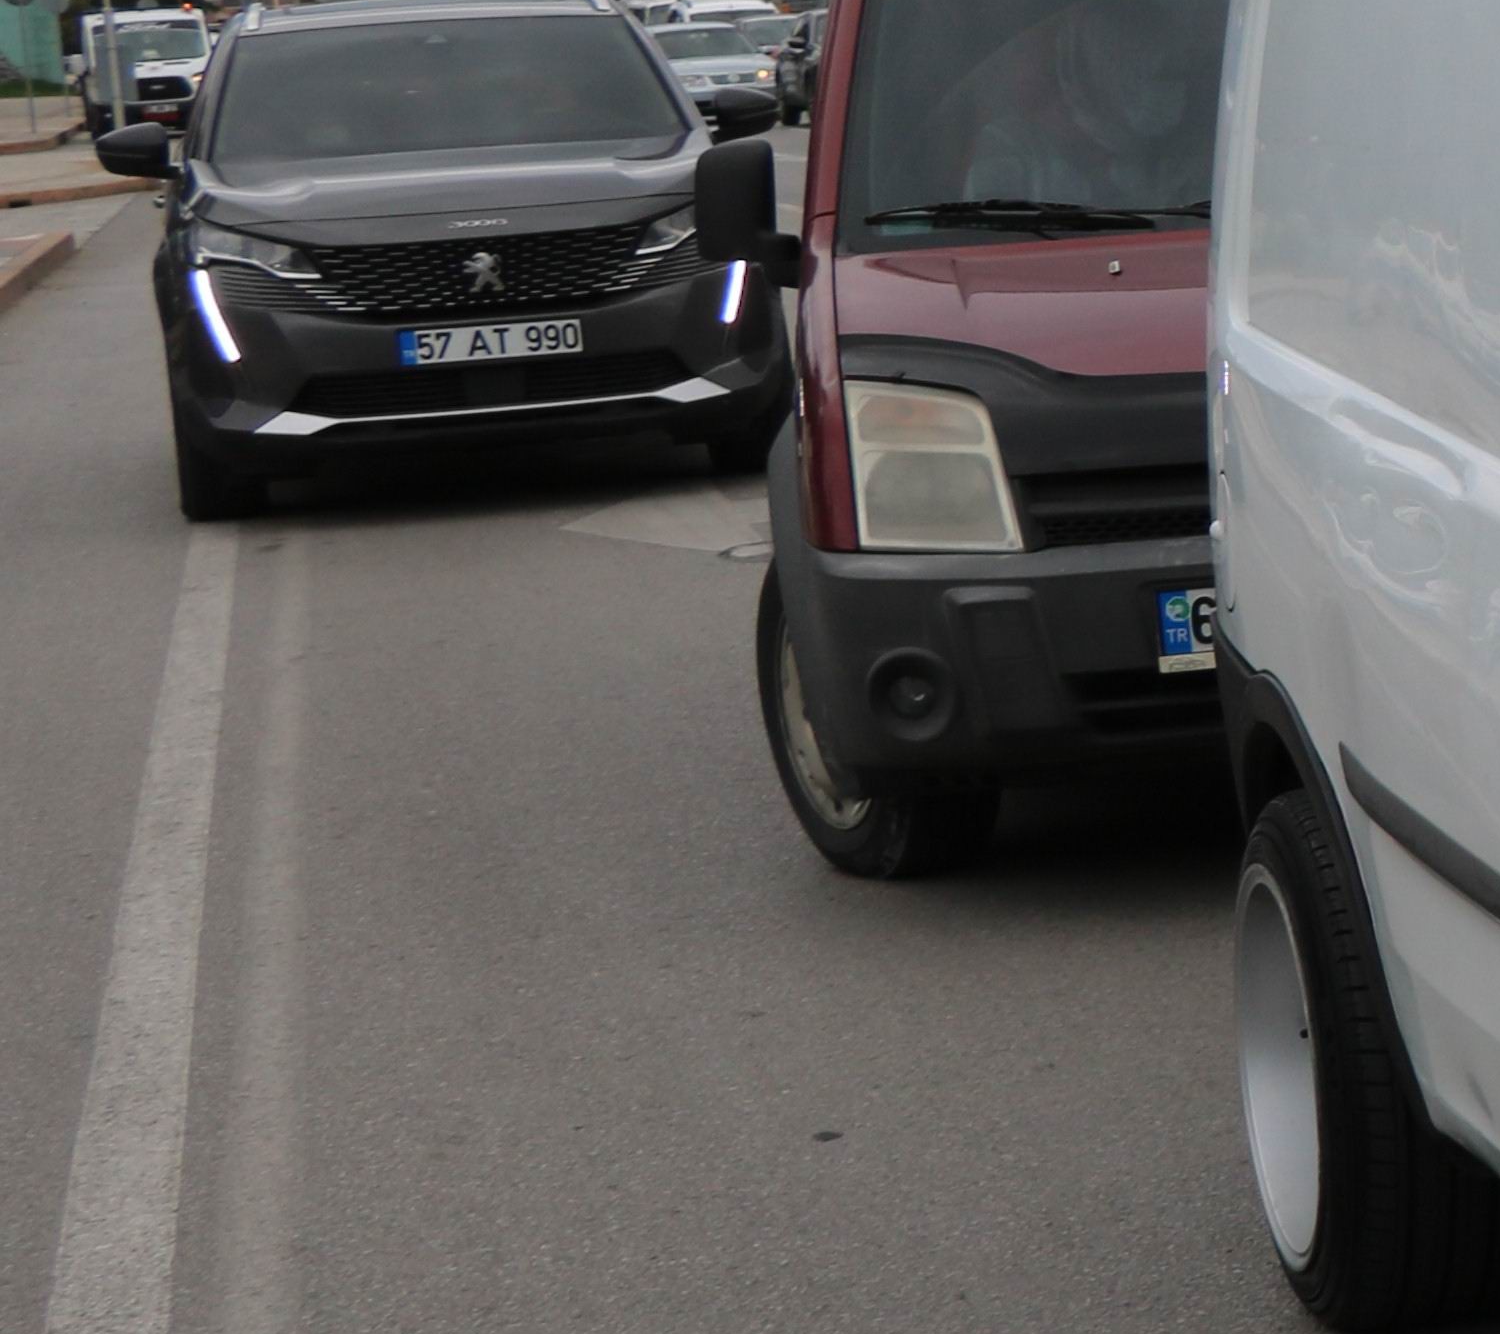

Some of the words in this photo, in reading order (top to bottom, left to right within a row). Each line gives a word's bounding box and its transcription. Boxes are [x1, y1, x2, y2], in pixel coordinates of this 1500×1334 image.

[416, 331, 452, 360] 57
[468, 327, 510, 357] AT
[525, 322, 579, 352] 990
[1166, 628, 1188, 643] TR
